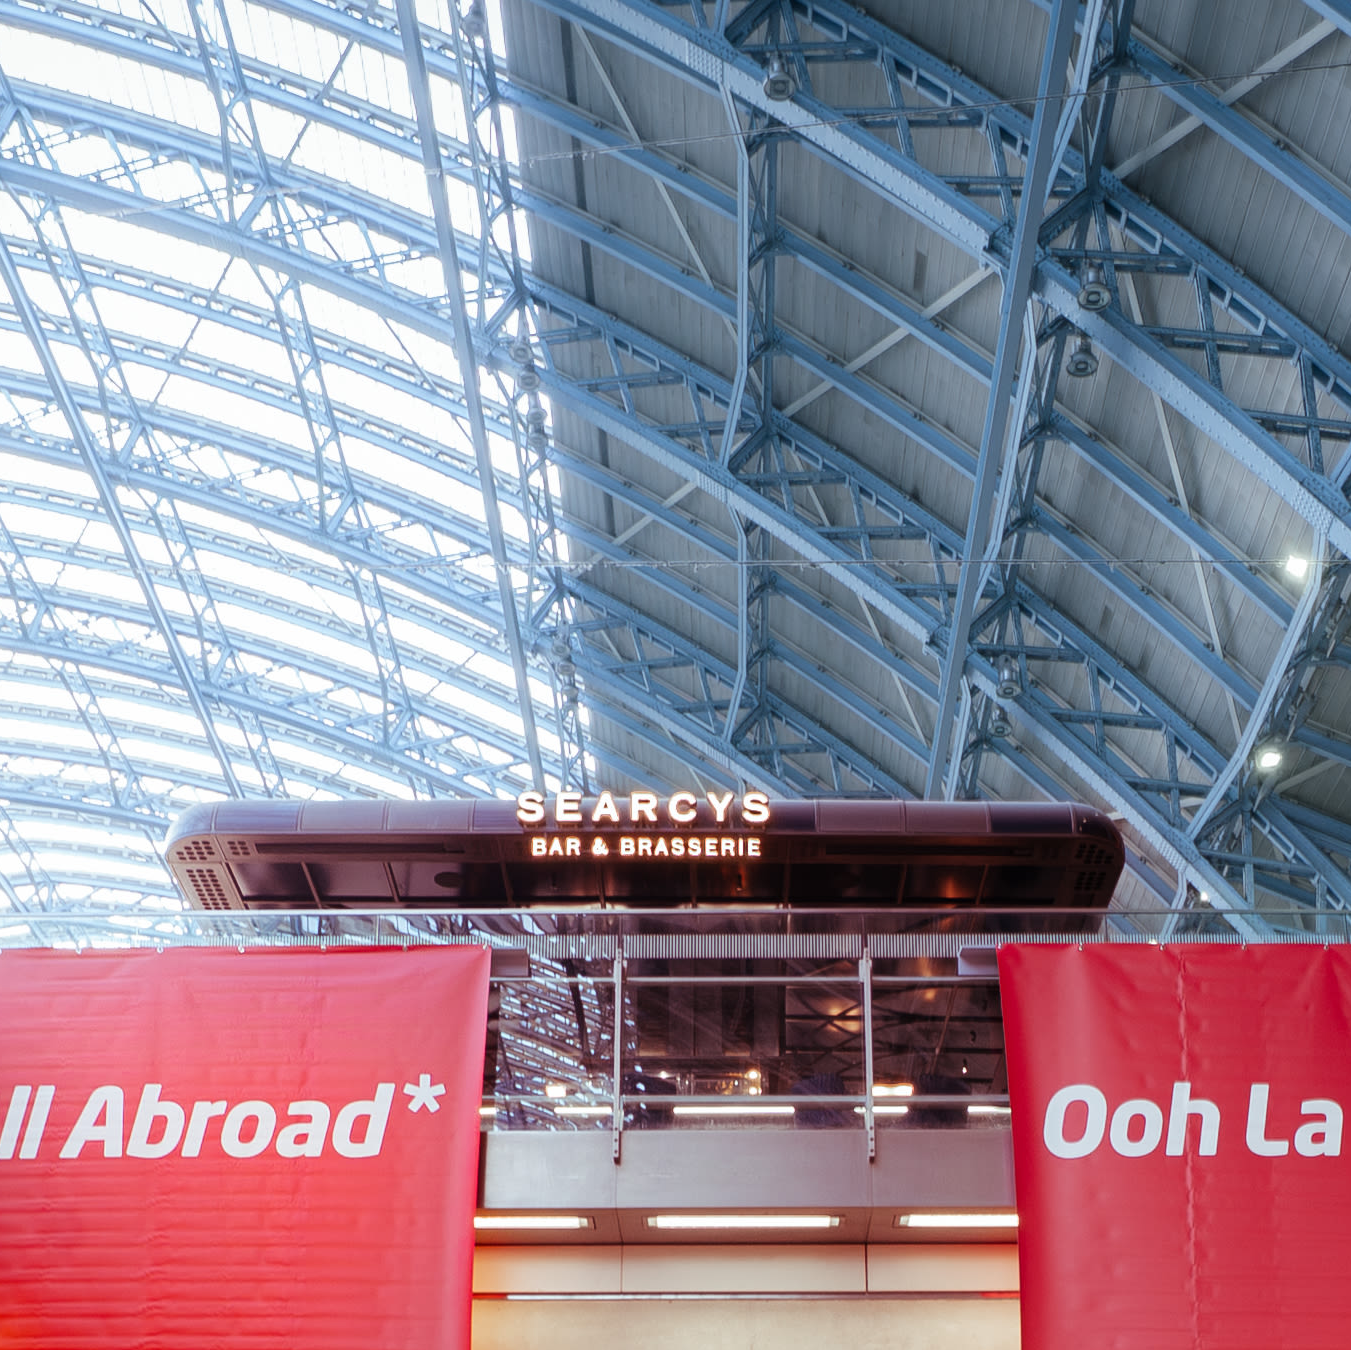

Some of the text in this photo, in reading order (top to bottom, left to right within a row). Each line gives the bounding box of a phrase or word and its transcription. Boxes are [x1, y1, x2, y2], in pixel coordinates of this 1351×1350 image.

[517, 791, 770, 823] SEARCYS
[531, 837, 762, 857] BAR & BRASSERIE
[1044, 1082, 1221, 1159] Ooh
[1246, 1083, 1344, 1157] La
